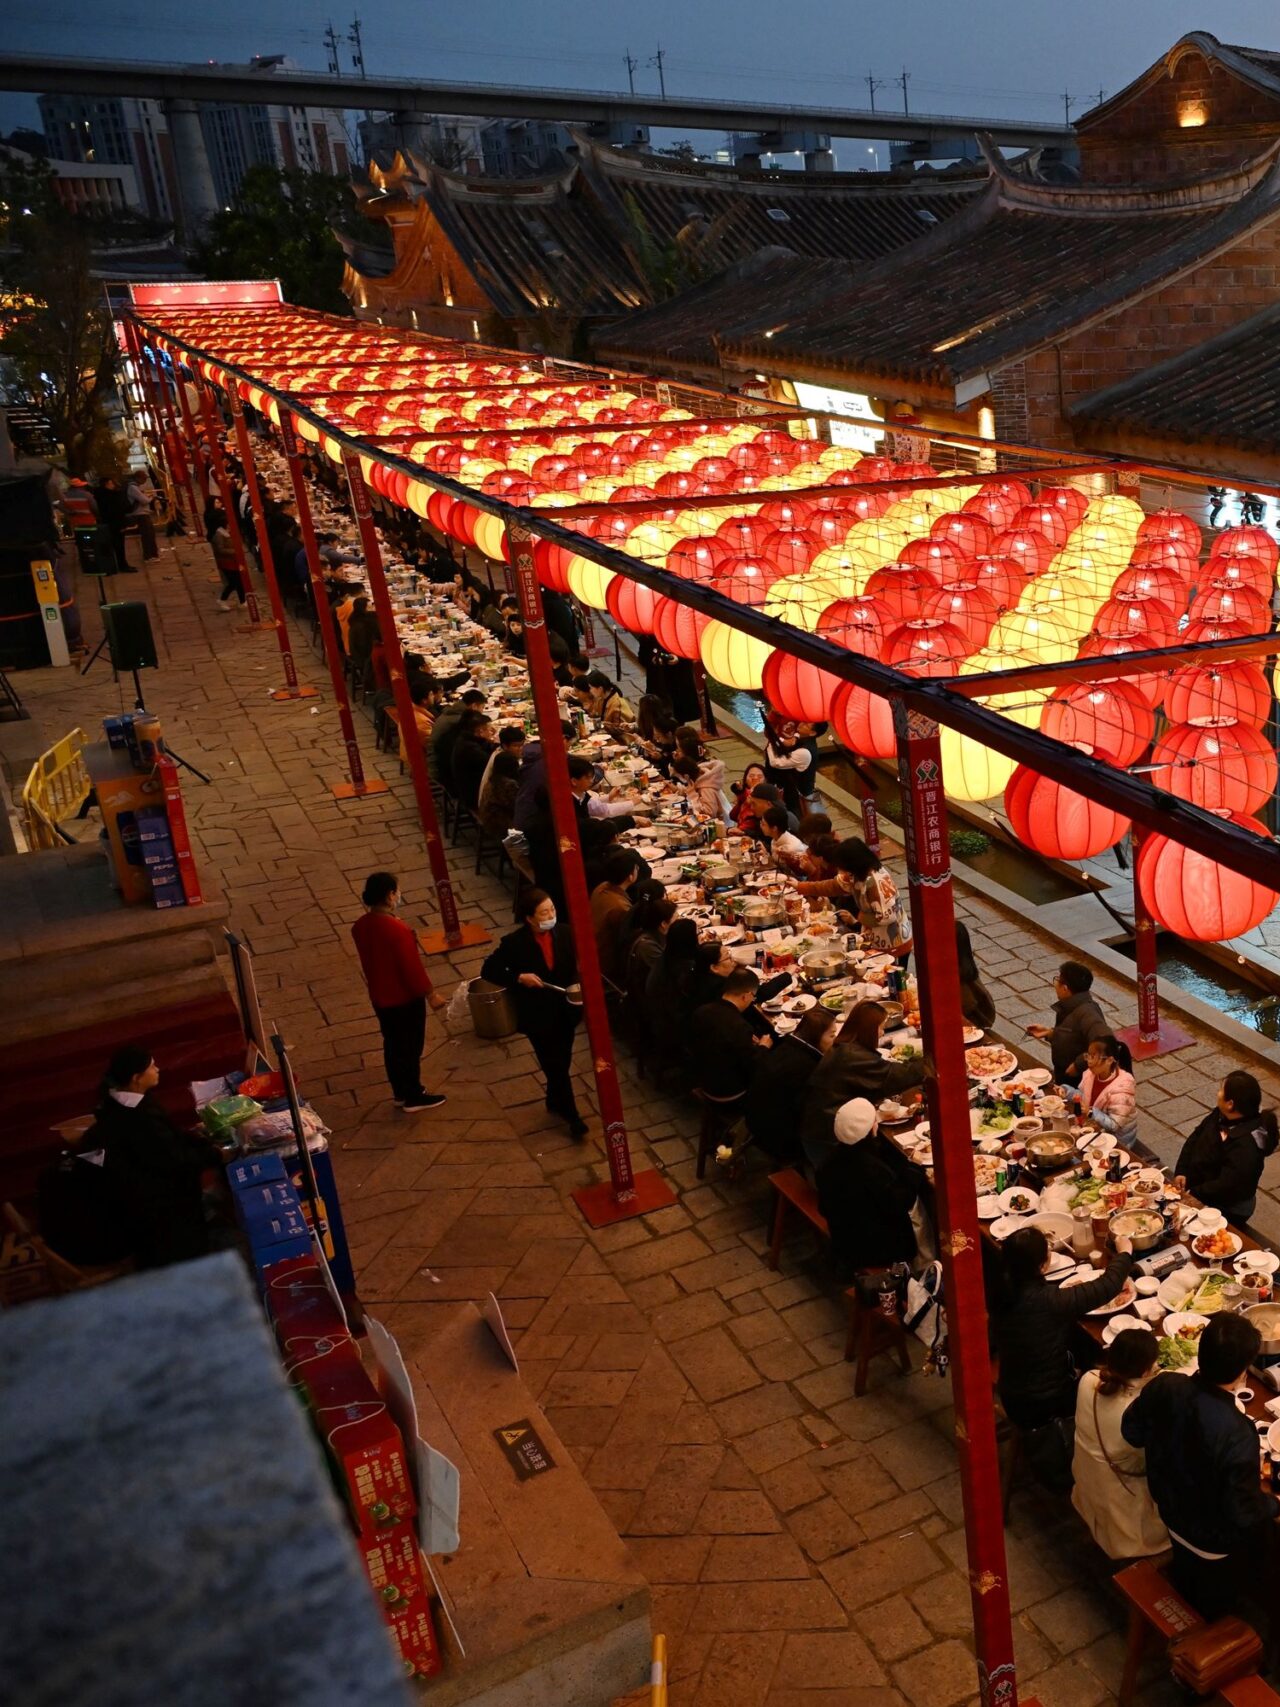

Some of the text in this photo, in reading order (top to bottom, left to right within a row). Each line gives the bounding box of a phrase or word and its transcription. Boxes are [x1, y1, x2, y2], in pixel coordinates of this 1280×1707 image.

[925, 790, 943, 865] 晋江农商银行
